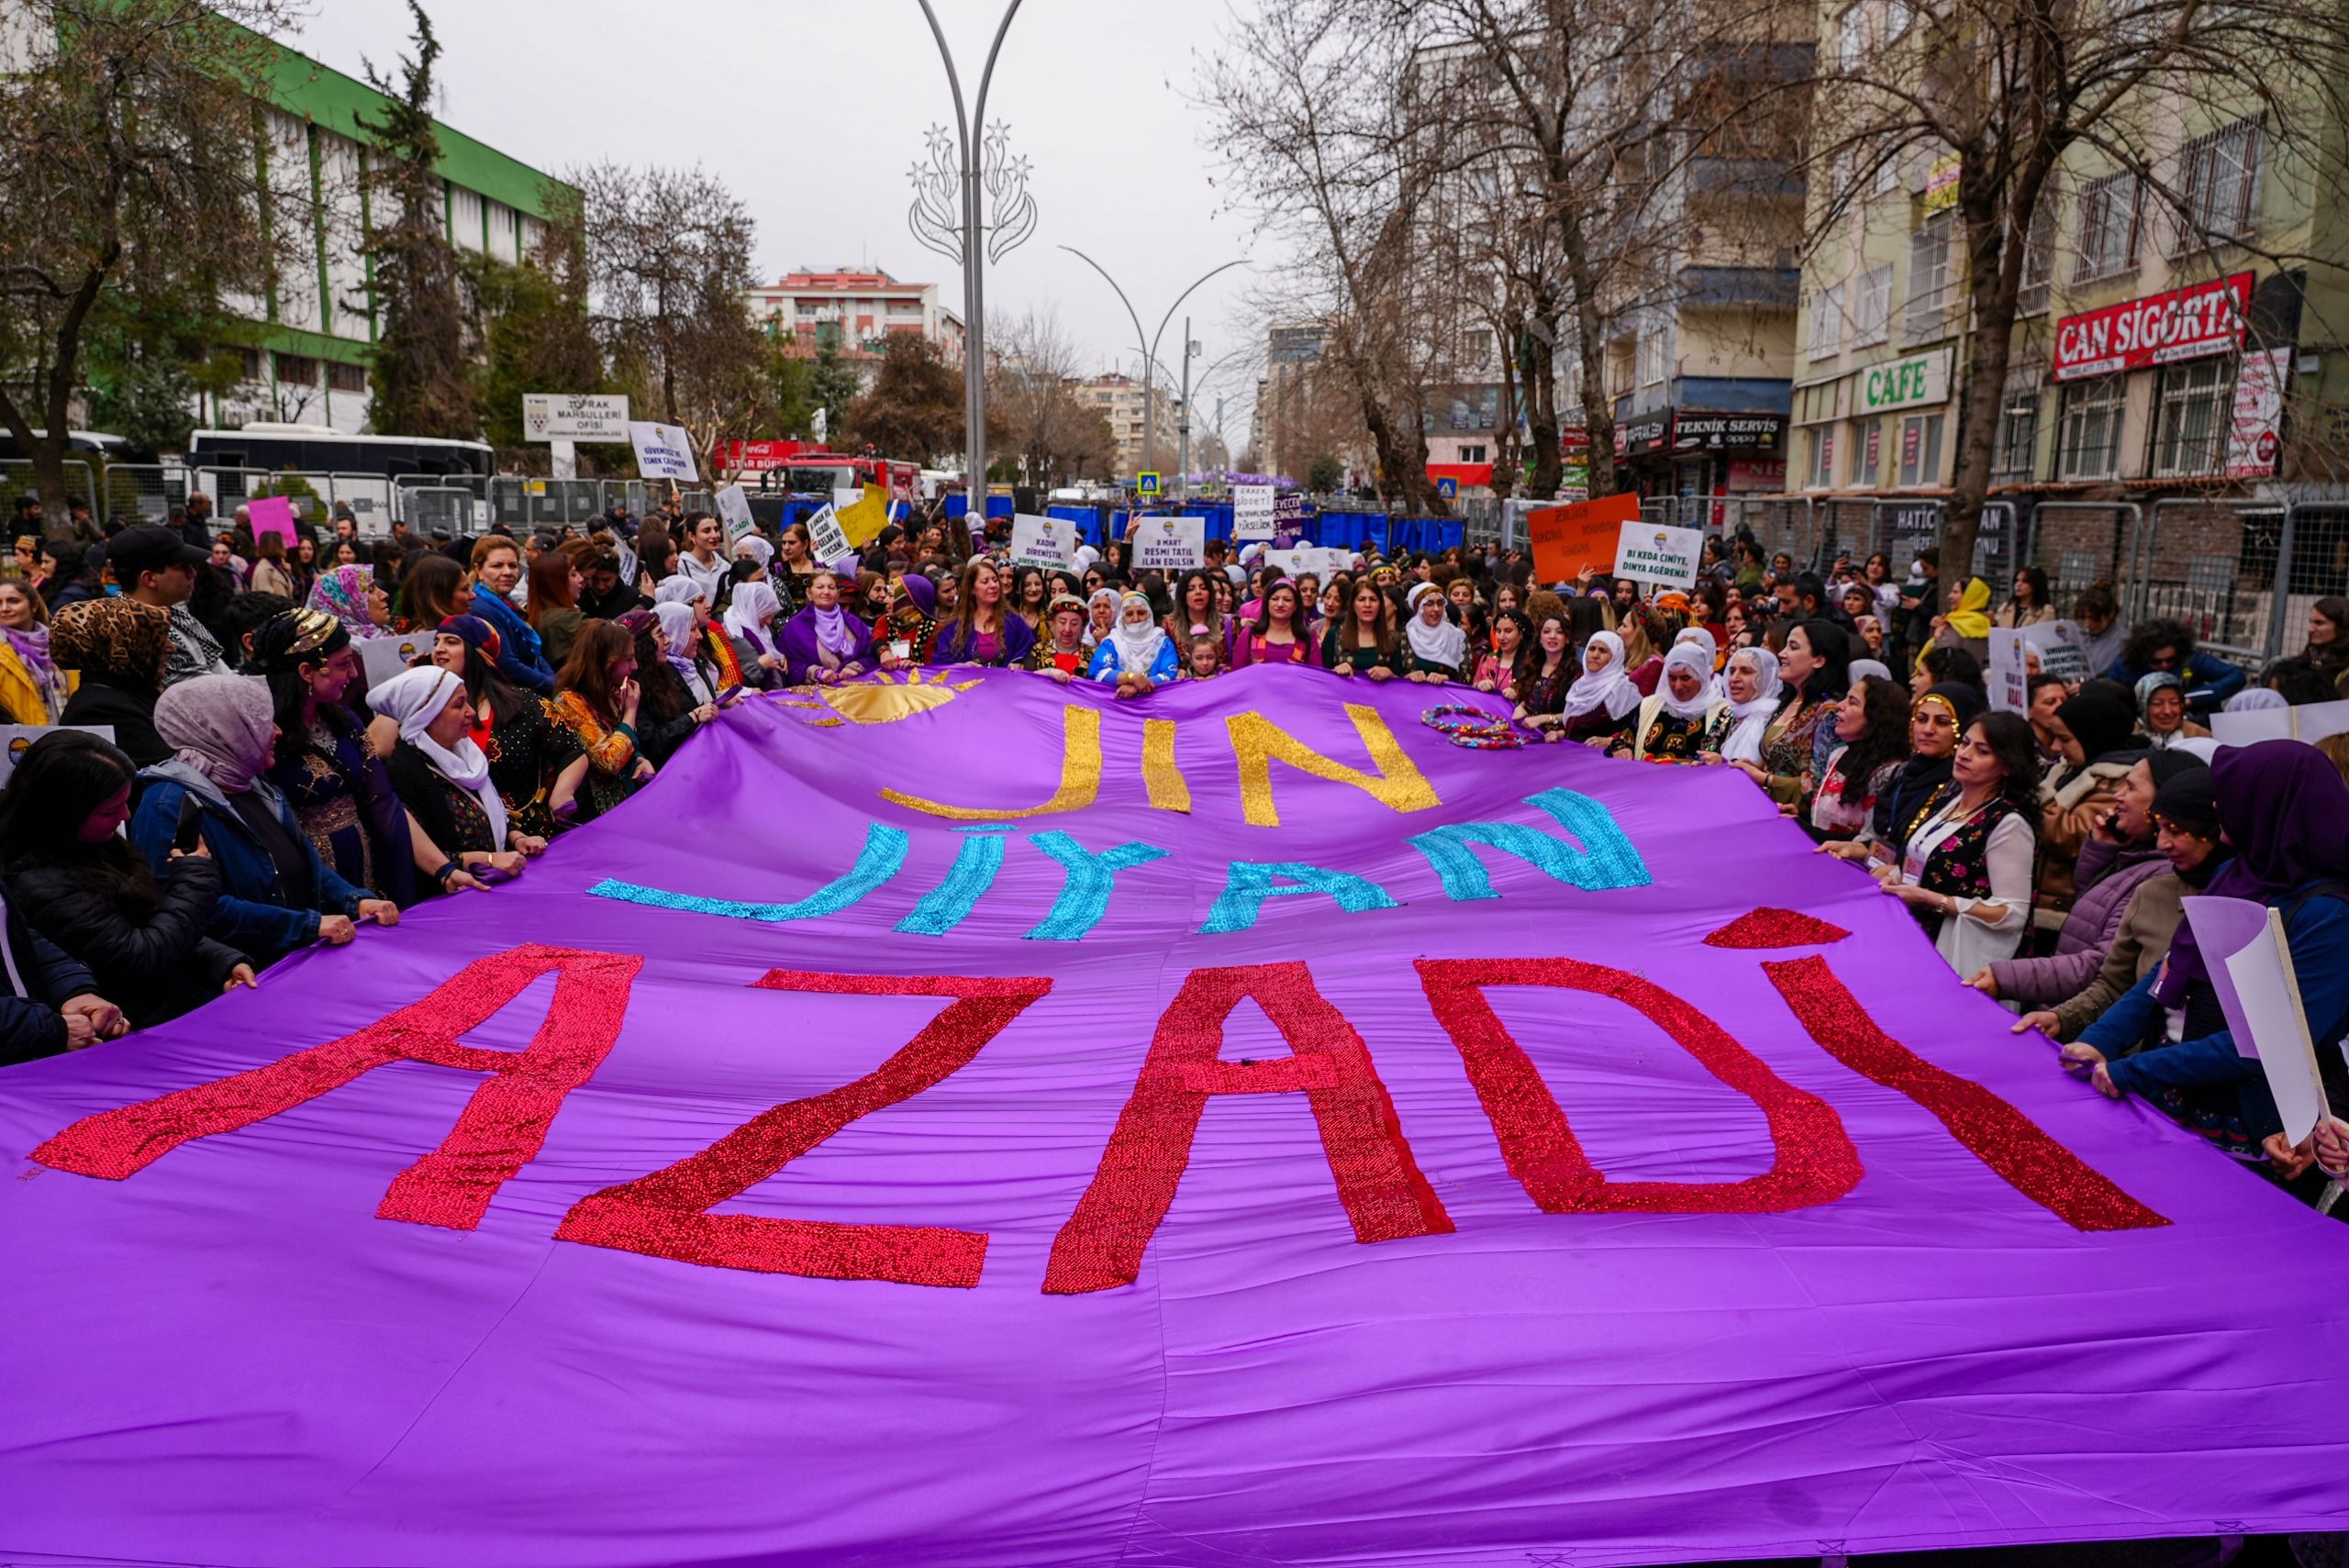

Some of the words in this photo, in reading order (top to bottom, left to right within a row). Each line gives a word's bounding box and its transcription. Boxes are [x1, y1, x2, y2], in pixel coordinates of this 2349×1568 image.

[2058, 316, 2111, 364] CAN
[2114, 285, 2244, 354] SİGORTA
[1866, 360, 1928, 406] CAFE
[567, 398, 609, 410] TOPRAK
[1675, 417, 1727, 434] TEKNİK
[1729, 417, 1778, 433] SERVİS
[1897, 506, 1936, 529] HATİC
[1036, 539, 1057, 548] KADIN
[1637, 550, 1658, 562] KEDA
[876, 702, 1441, 827] JIN
